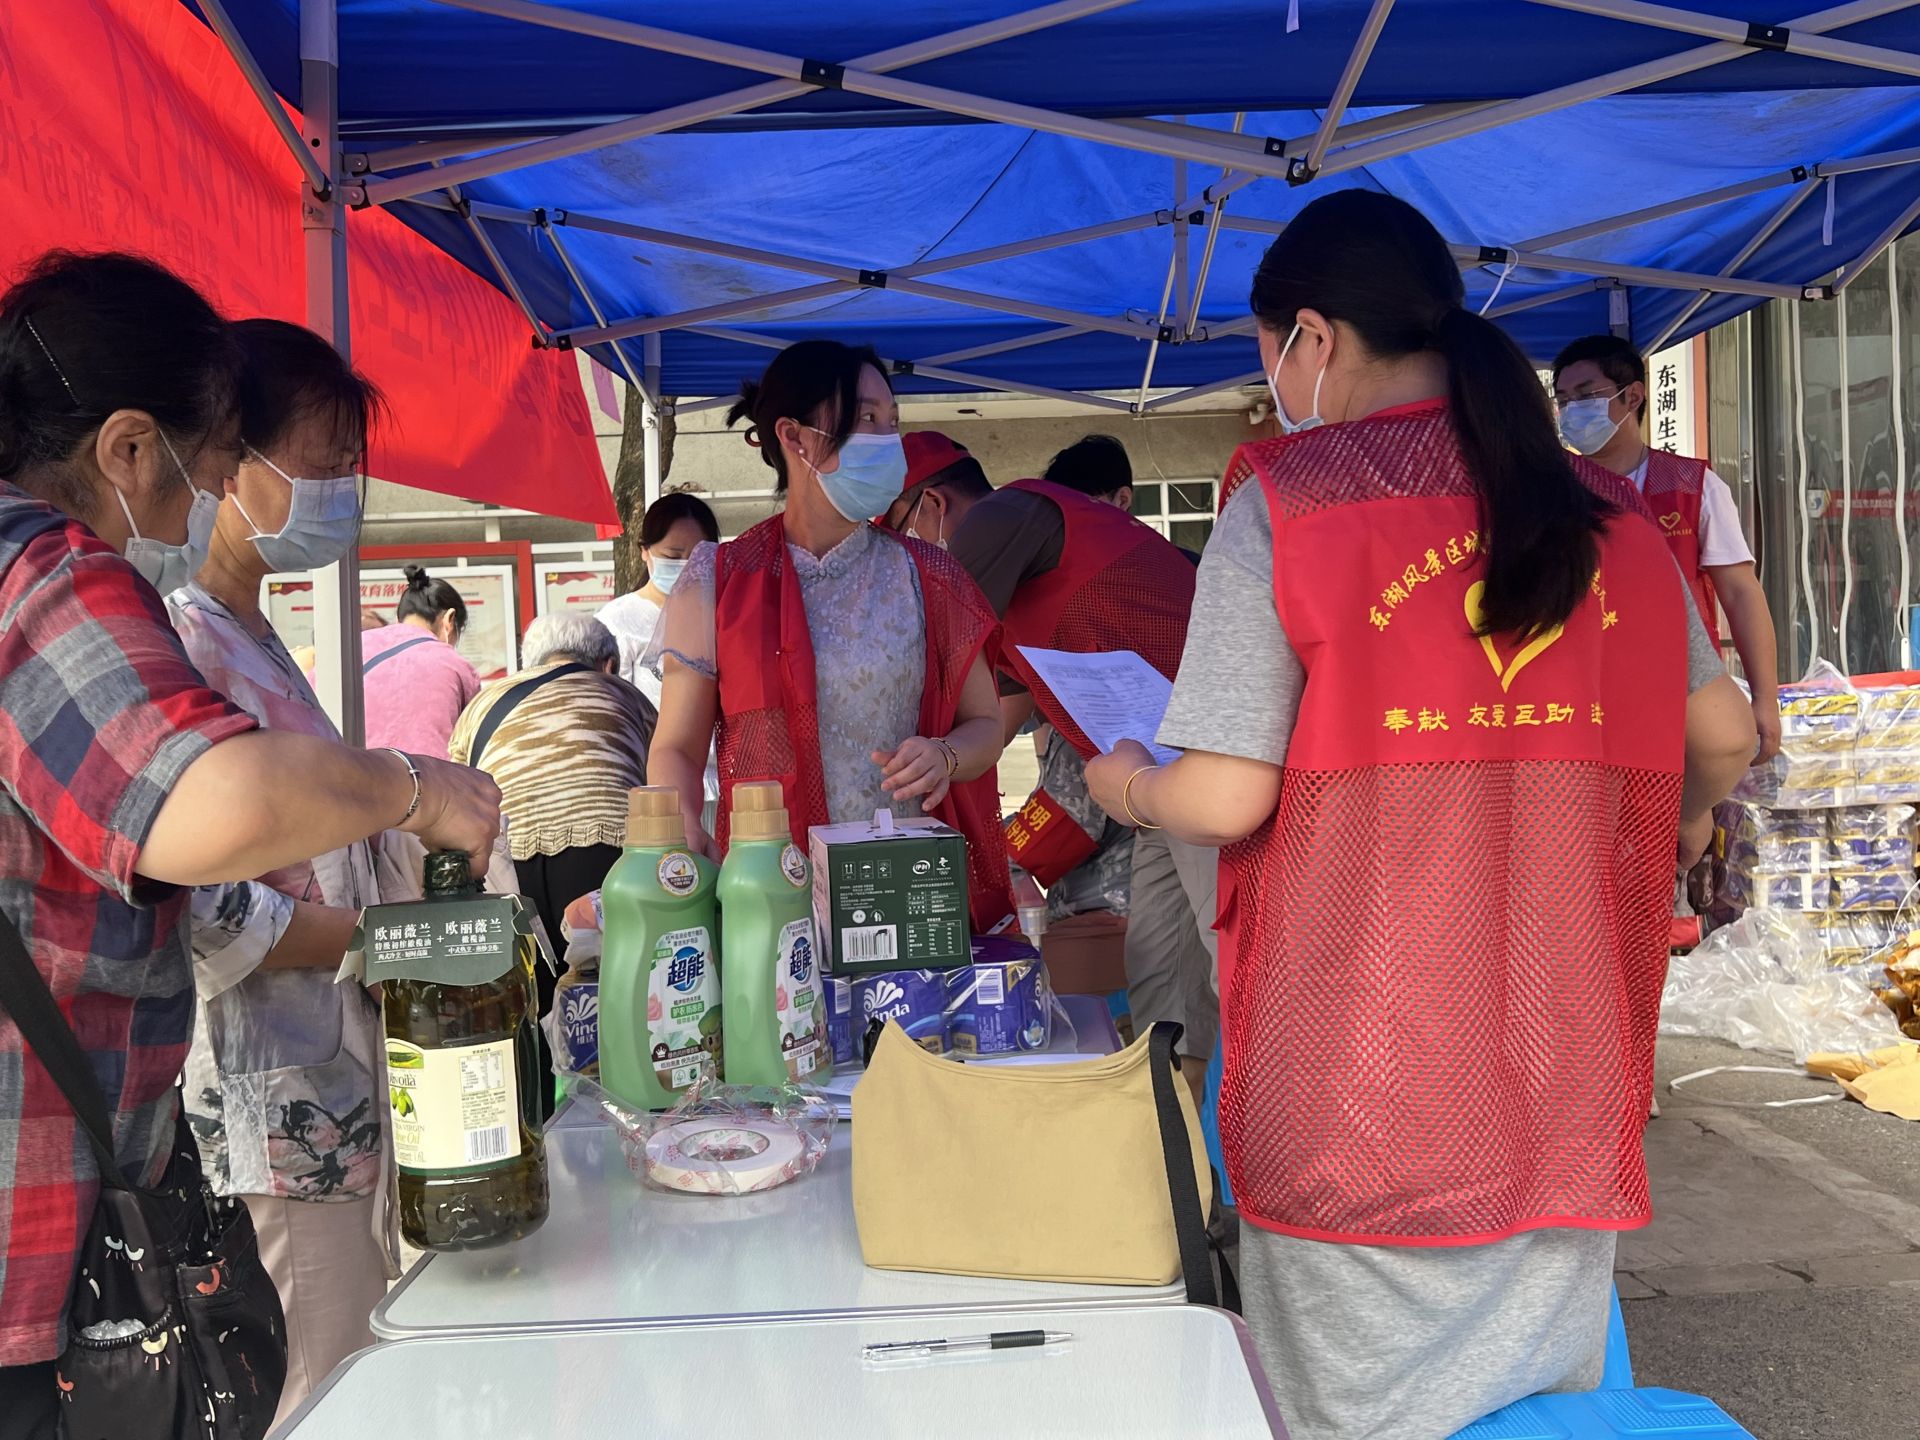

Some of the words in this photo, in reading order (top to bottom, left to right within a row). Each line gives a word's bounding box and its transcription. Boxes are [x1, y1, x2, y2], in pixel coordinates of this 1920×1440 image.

[1382, 707, 1450, 735] 奉献
[1021, 797, 1052, 832] 文明
[374, 922, 432, 941] 欧丽薇兰
[445, 918, 503, 935] 欧丽薇兰
[461, 935, 487, 944] 橄榄油
[374, 937, 432, 951] 特级初榨橄榄油
[667, 951, 705, 987] 超能
[790, 944, 813, 977] 超能
